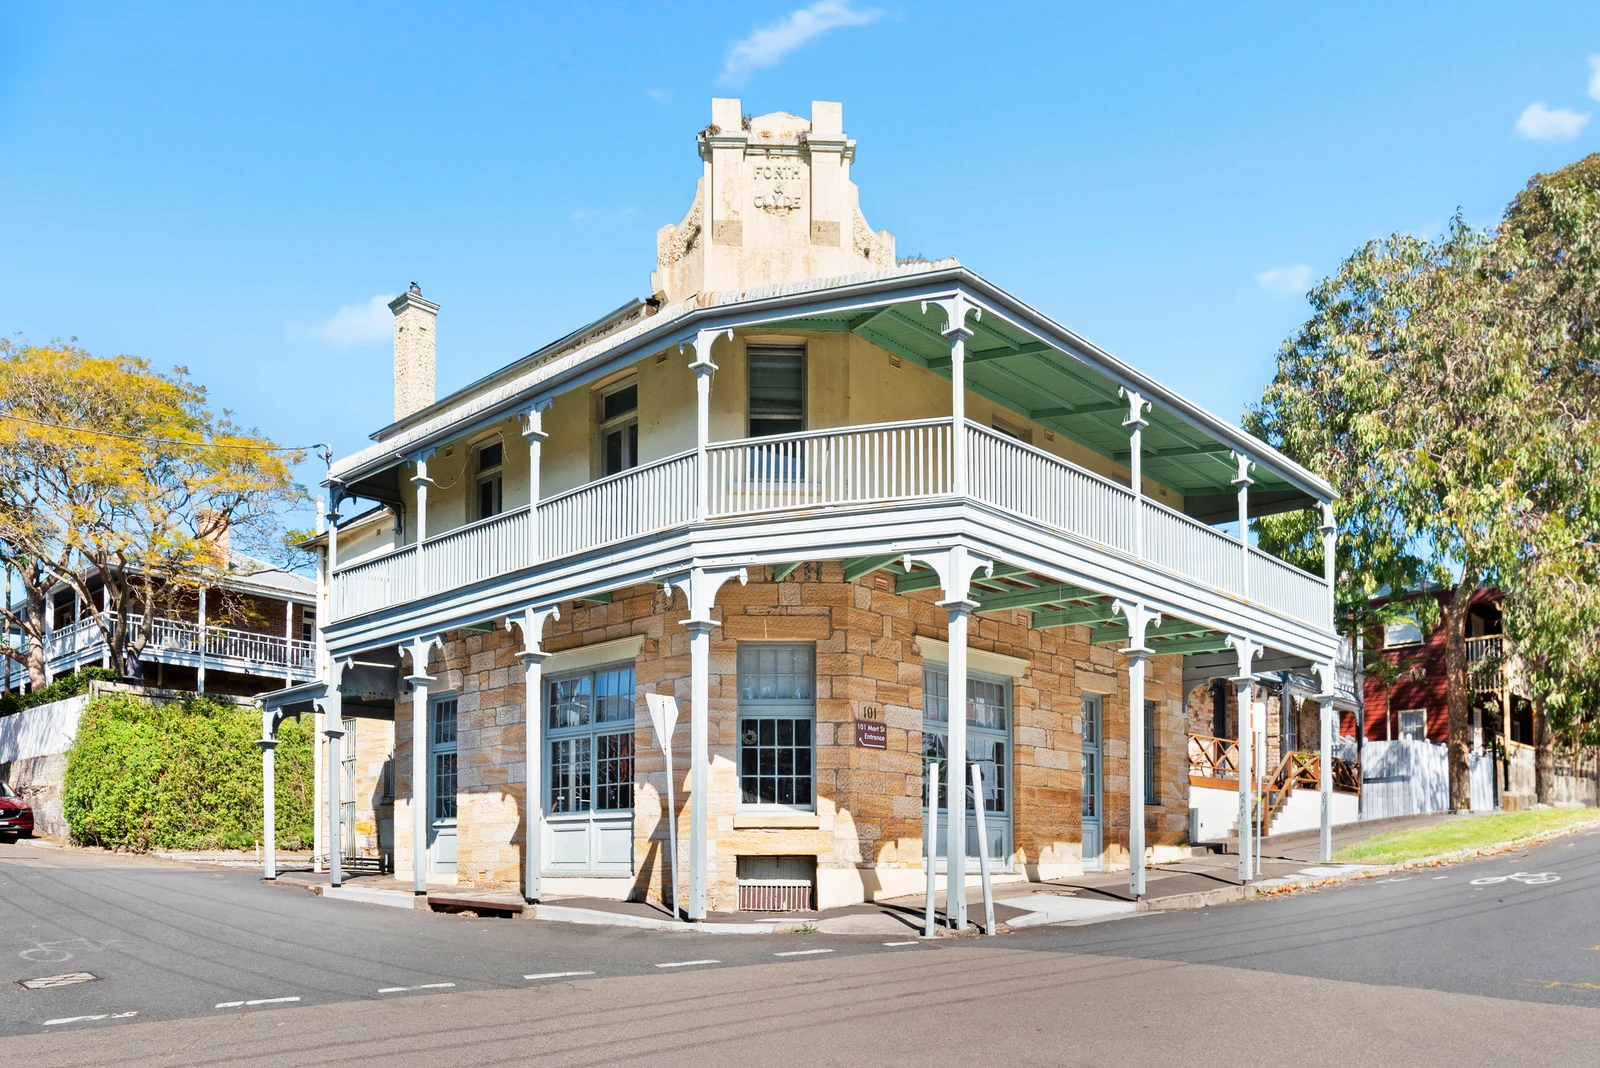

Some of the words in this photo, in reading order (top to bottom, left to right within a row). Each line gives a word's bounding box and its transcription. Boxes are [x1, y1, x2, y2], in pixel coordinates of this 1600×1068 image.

[753, 166, 800, 179] FORTH
[773, 180, 784, 195] &
[753, 195, 801, 209] CLYDE
[863, 706, 877, 719] 101
[857, 723, 866, 731] 101
[864, 733, 885, 741] Entrance
